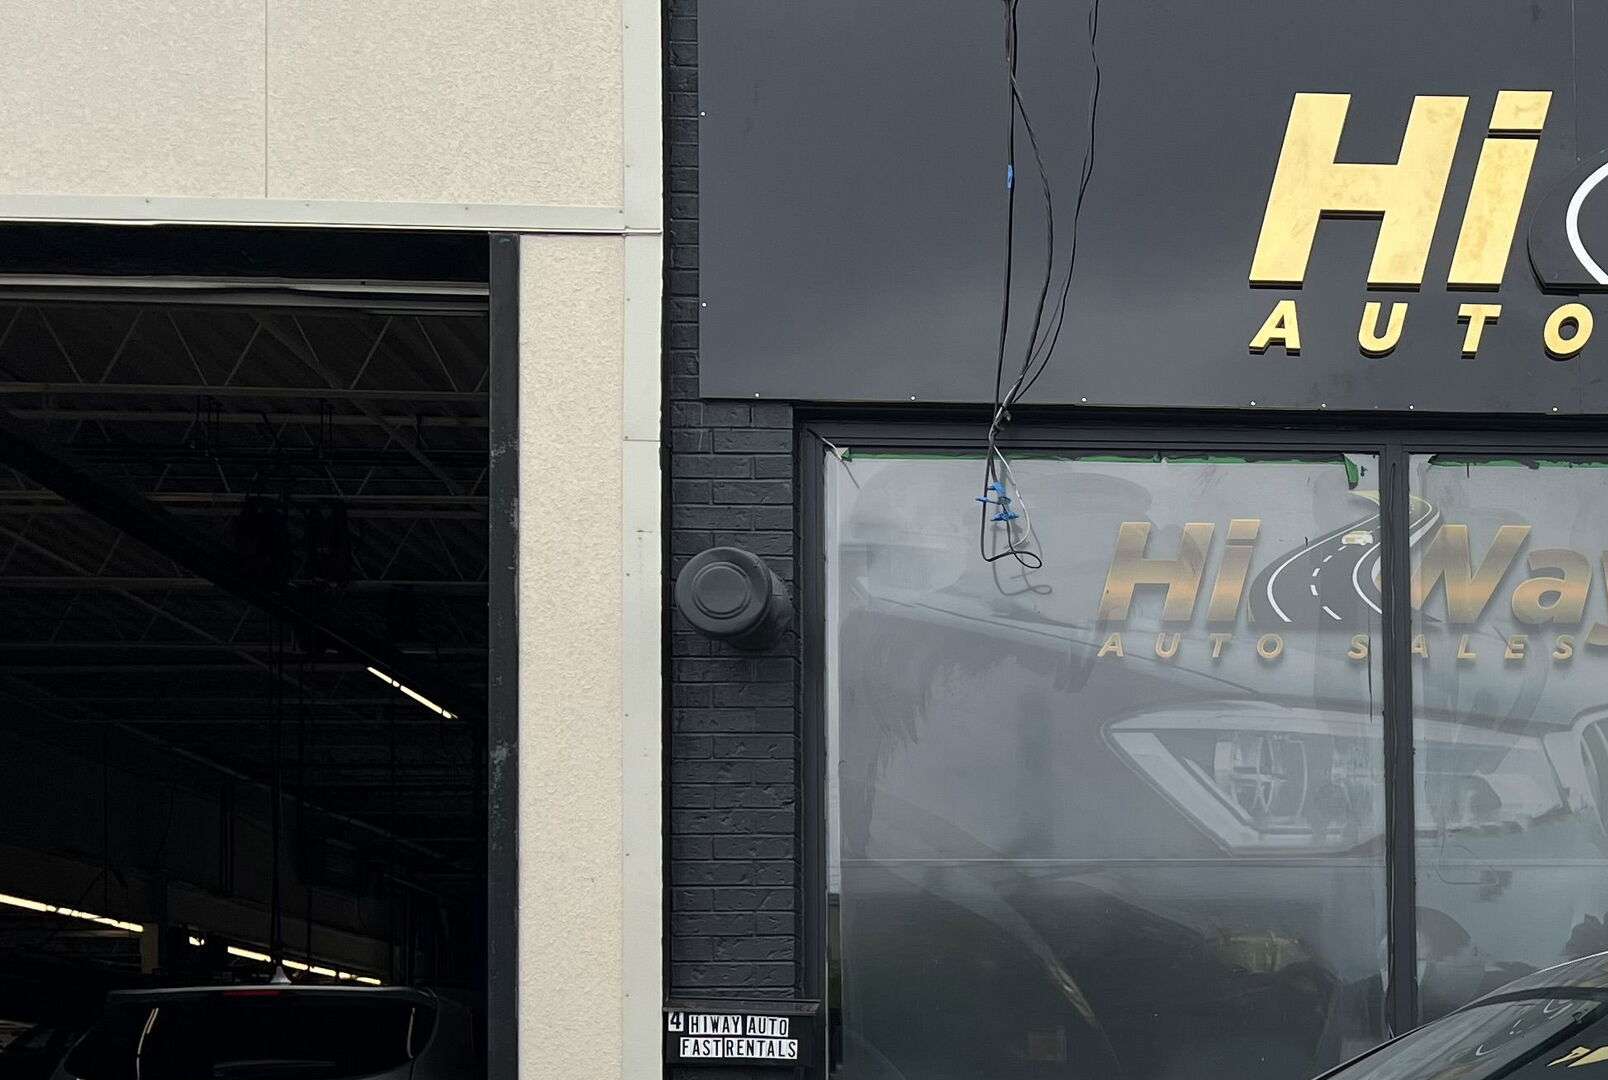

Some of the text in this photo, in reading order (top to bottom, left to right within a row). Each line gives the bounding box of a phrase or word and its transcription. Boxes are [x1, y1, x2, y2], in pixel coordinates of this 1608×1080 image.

[1249, 90, 1552, 291] Hi
[1249, 301, 1595, 360] AUTO
[1097, 518, 1262, 622] Hi
[1097, 631, 1575, 662] AUTO SALES
[670, 1012, 788, 1035] 4 HIWAY AUTO
[682, 1039, 796, 1057] FAST RENTALS
